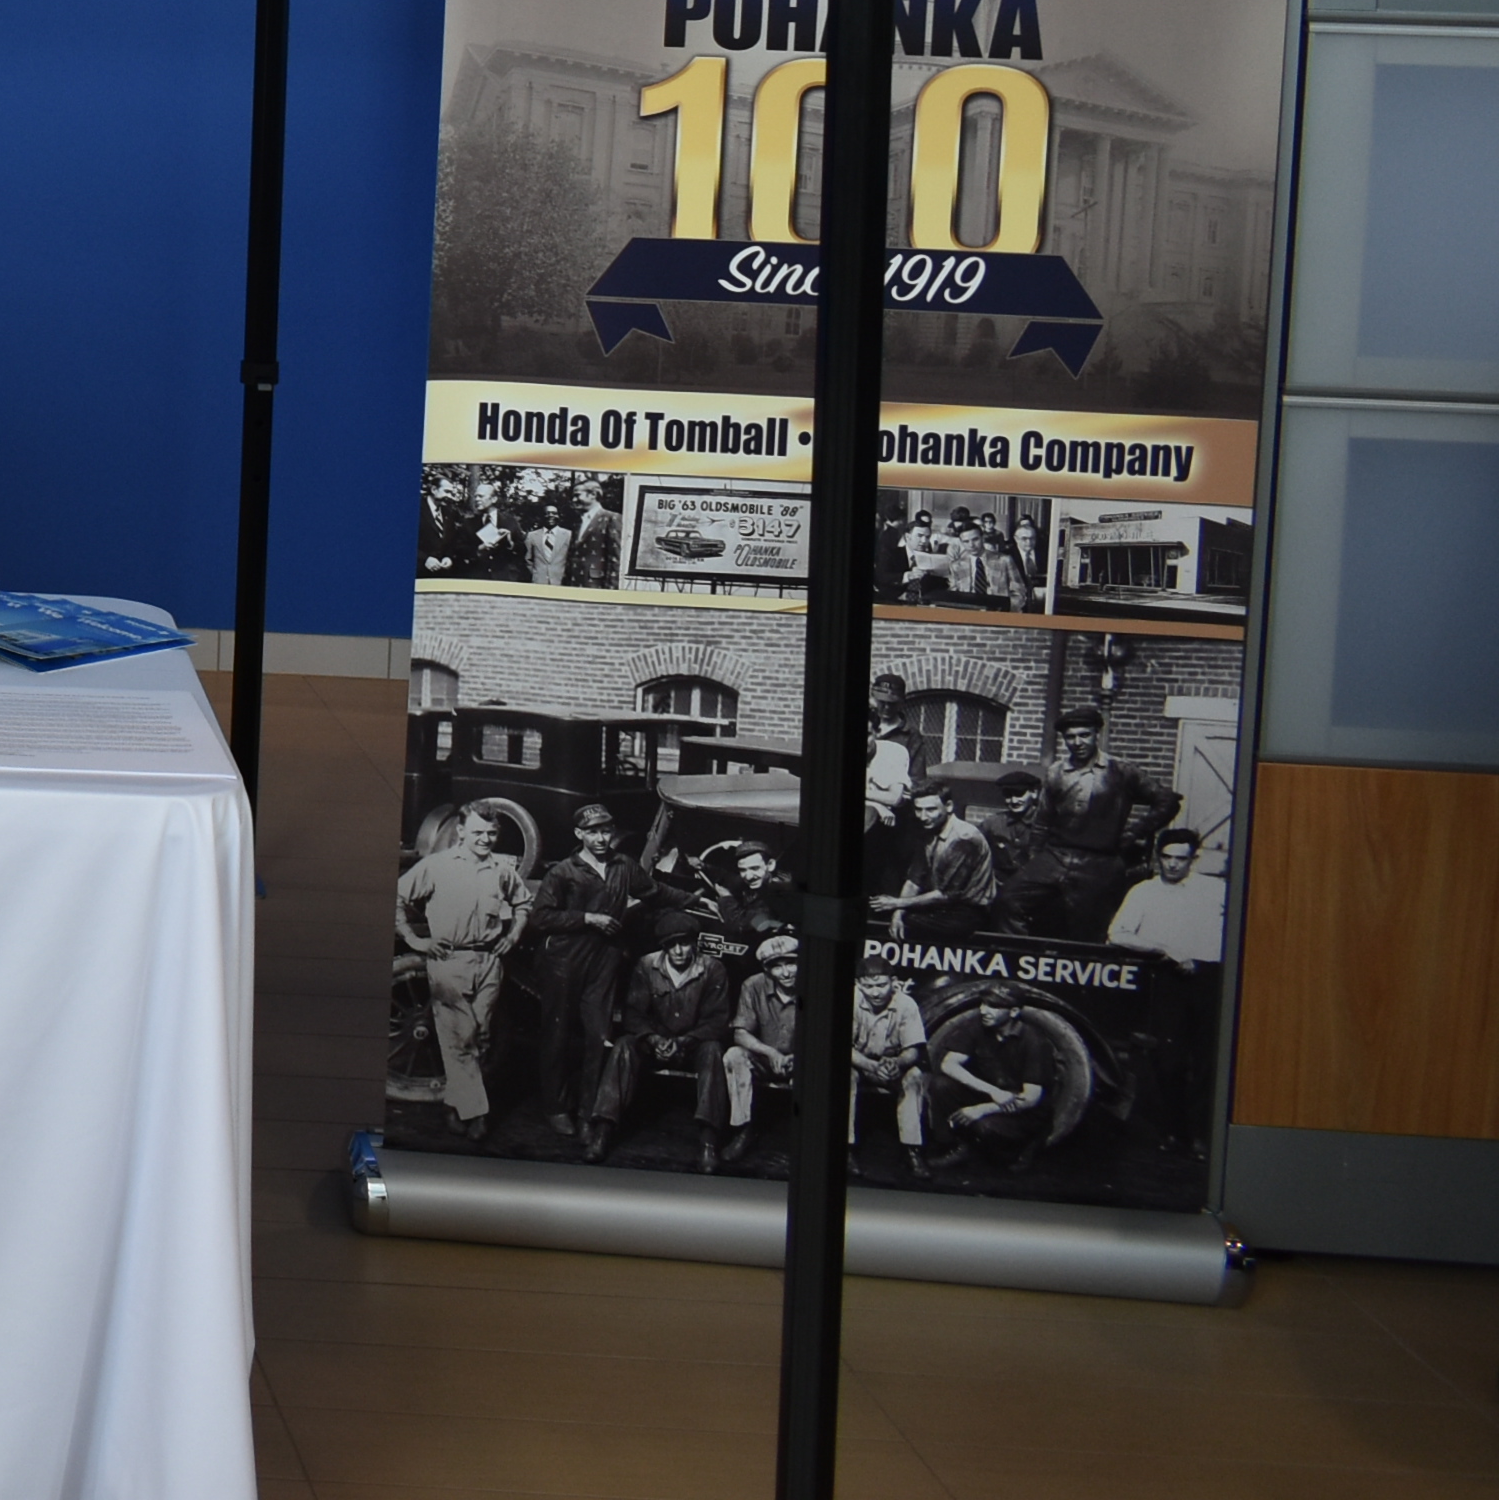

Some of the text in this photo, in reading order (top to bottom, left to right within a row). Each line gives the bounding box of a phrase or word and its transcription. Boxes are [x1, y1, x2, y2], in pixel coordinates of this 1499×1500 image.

[475, 401, 1195, 485] Honda Of Tomball ohanka Company
[657, 499, 677, 511] BIG
[700, 500, 774, 517] OLDSMOBILE
[863, 938, 1139, 991] POHANKA SERVICE
